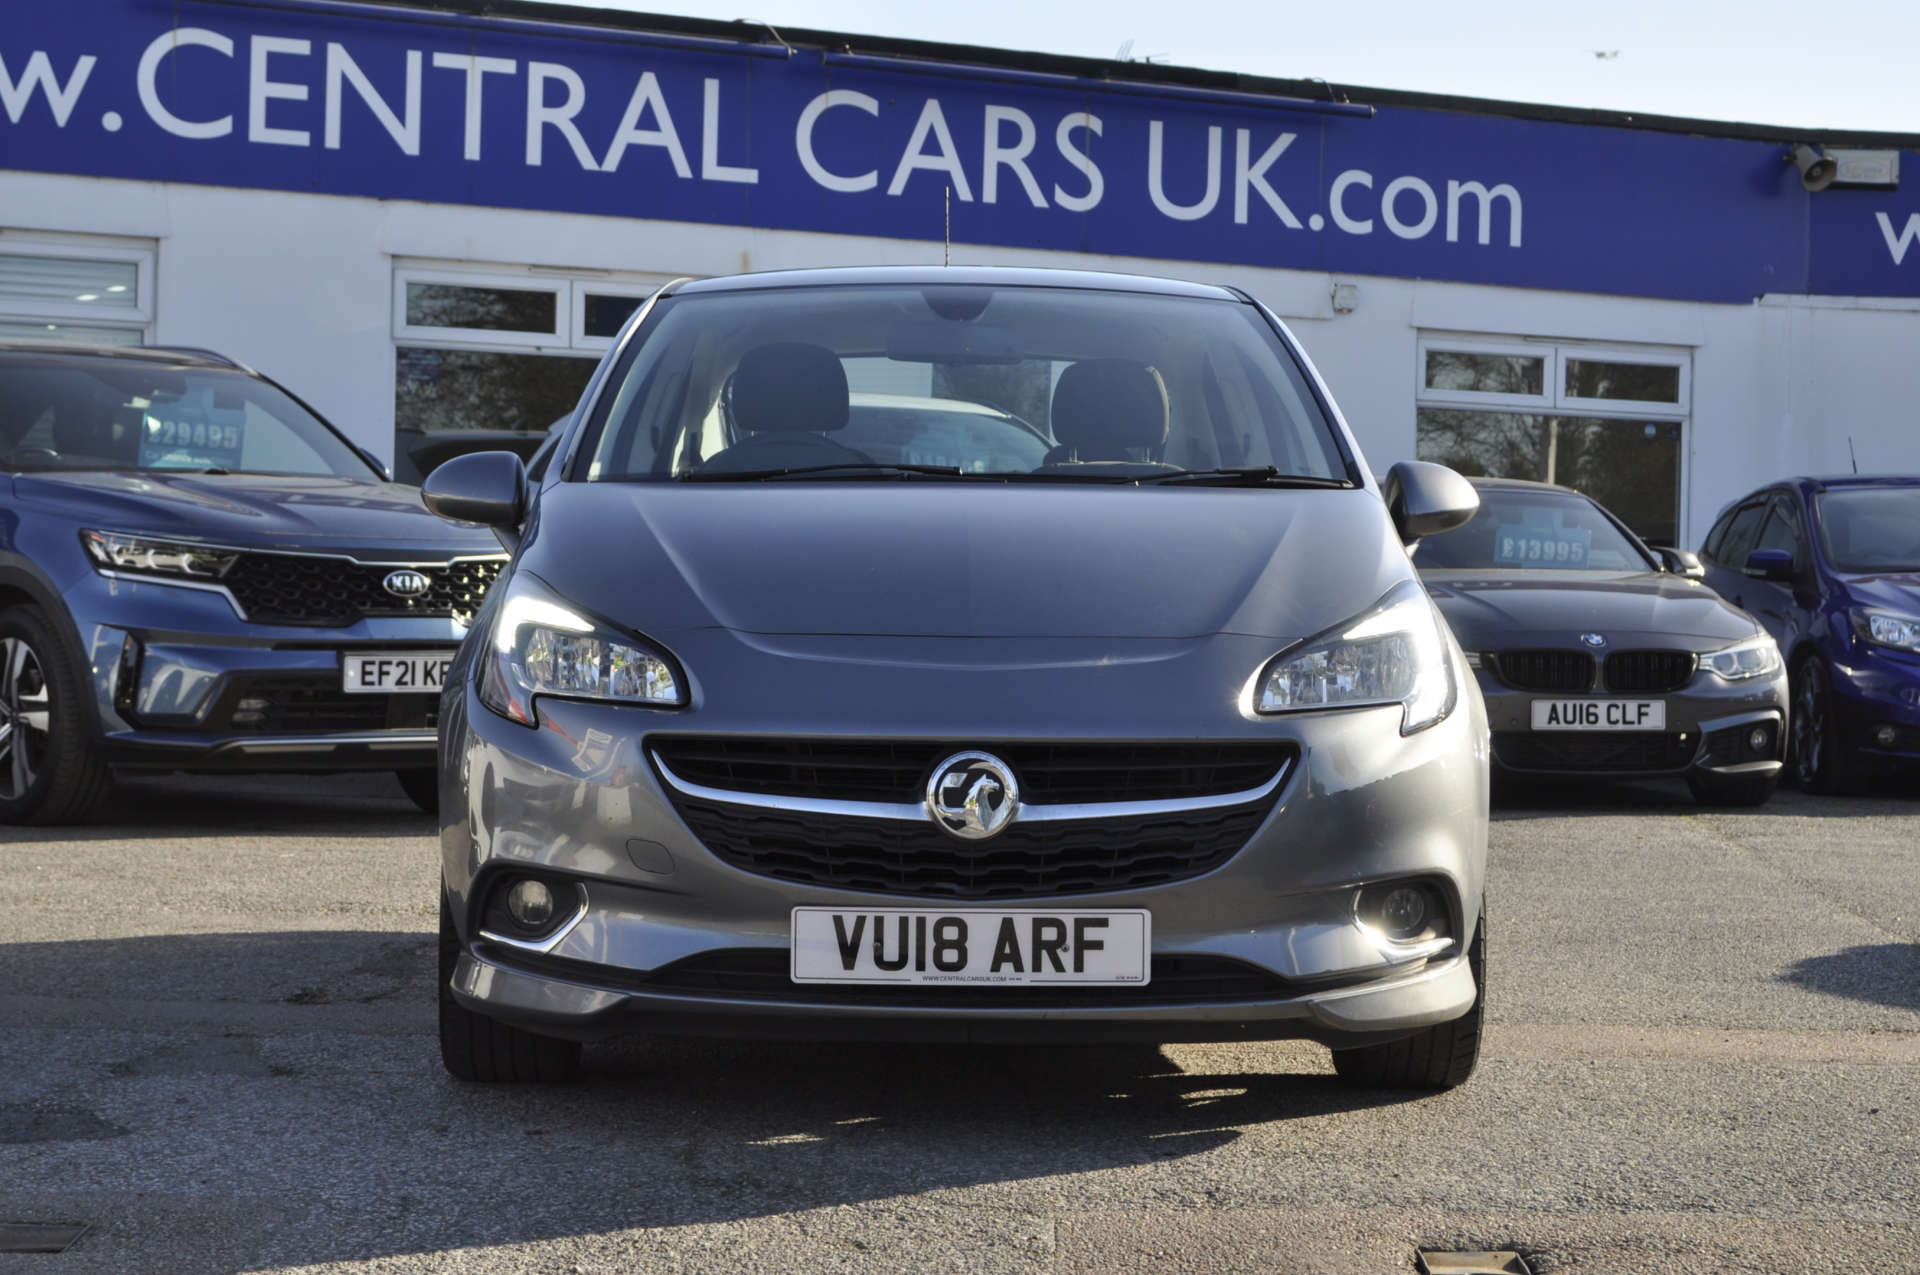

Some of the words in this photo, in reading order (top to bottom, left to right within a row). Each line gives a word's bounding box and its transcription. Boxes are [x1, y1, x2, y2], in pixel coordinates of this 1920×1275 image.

[795, 89, 1105, 212] CARS
[1148, 120, 1522, 247] UK.com
[1502, 537, 1583, 561] £13995
[391, 576, 423, 591] KIA
[361, 660, 416, 686] EF21
[1547, 703, 1599, 725] AU16
[1606, 703, 1651, 725] CLF
[832, 914, 969, 973] VU18
[990, 916, 1110, 974] ARF
